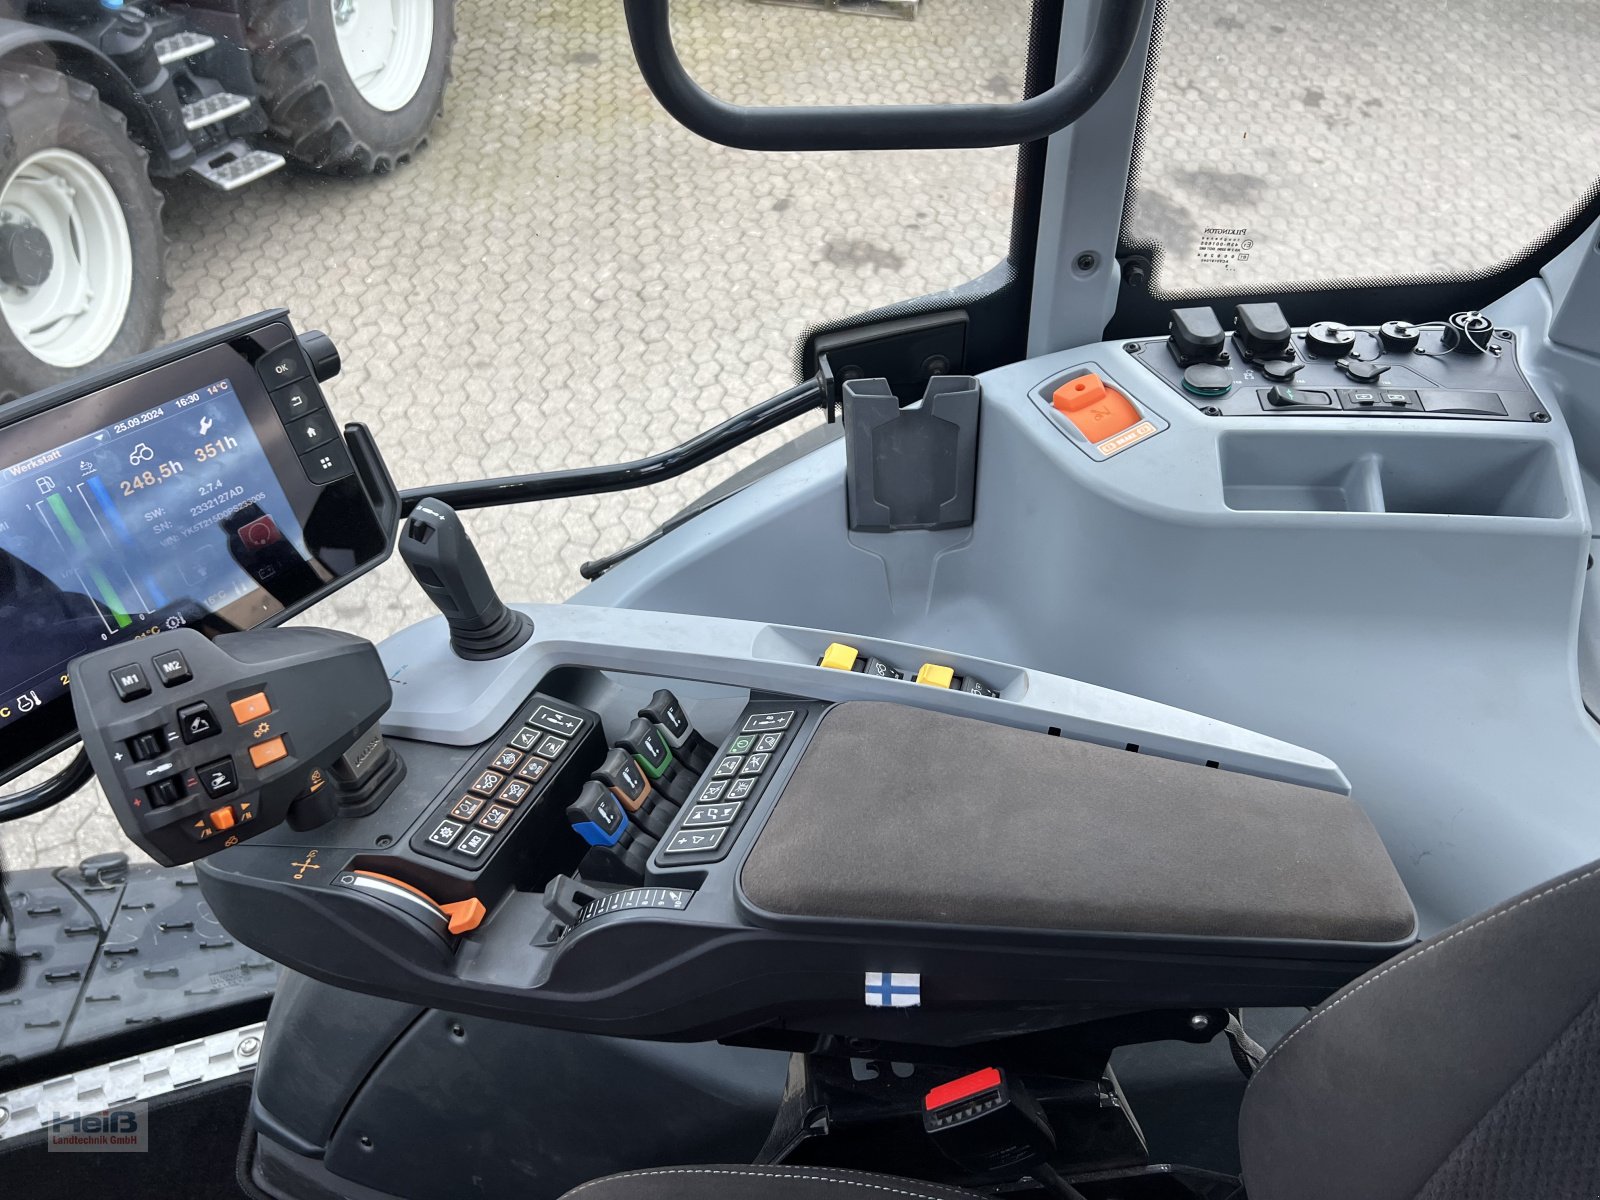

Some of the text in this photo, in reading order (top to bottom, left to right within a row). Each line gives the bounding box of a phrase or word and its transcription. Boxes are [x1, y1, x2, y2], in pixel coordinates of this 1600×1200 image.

[275, 363, 289, 374] OK
[114, 381, 228, 433] 25.09.2024 16:30 14°C
[194, 436, 238, 462] 351h
[10, 450, 62, 476] Werkstatt
[120, 460, 184, 496] 248,5h
[144, 480, 223, 522] SW: 2.7.4
[152, 486, 244, 534] SN: 2332127AD
[101, 632, 108, 641] 0
[162, 660, 182, 673] M2
[121, 674, 139, 687] M1
[468, 835, 482, 848] M3
